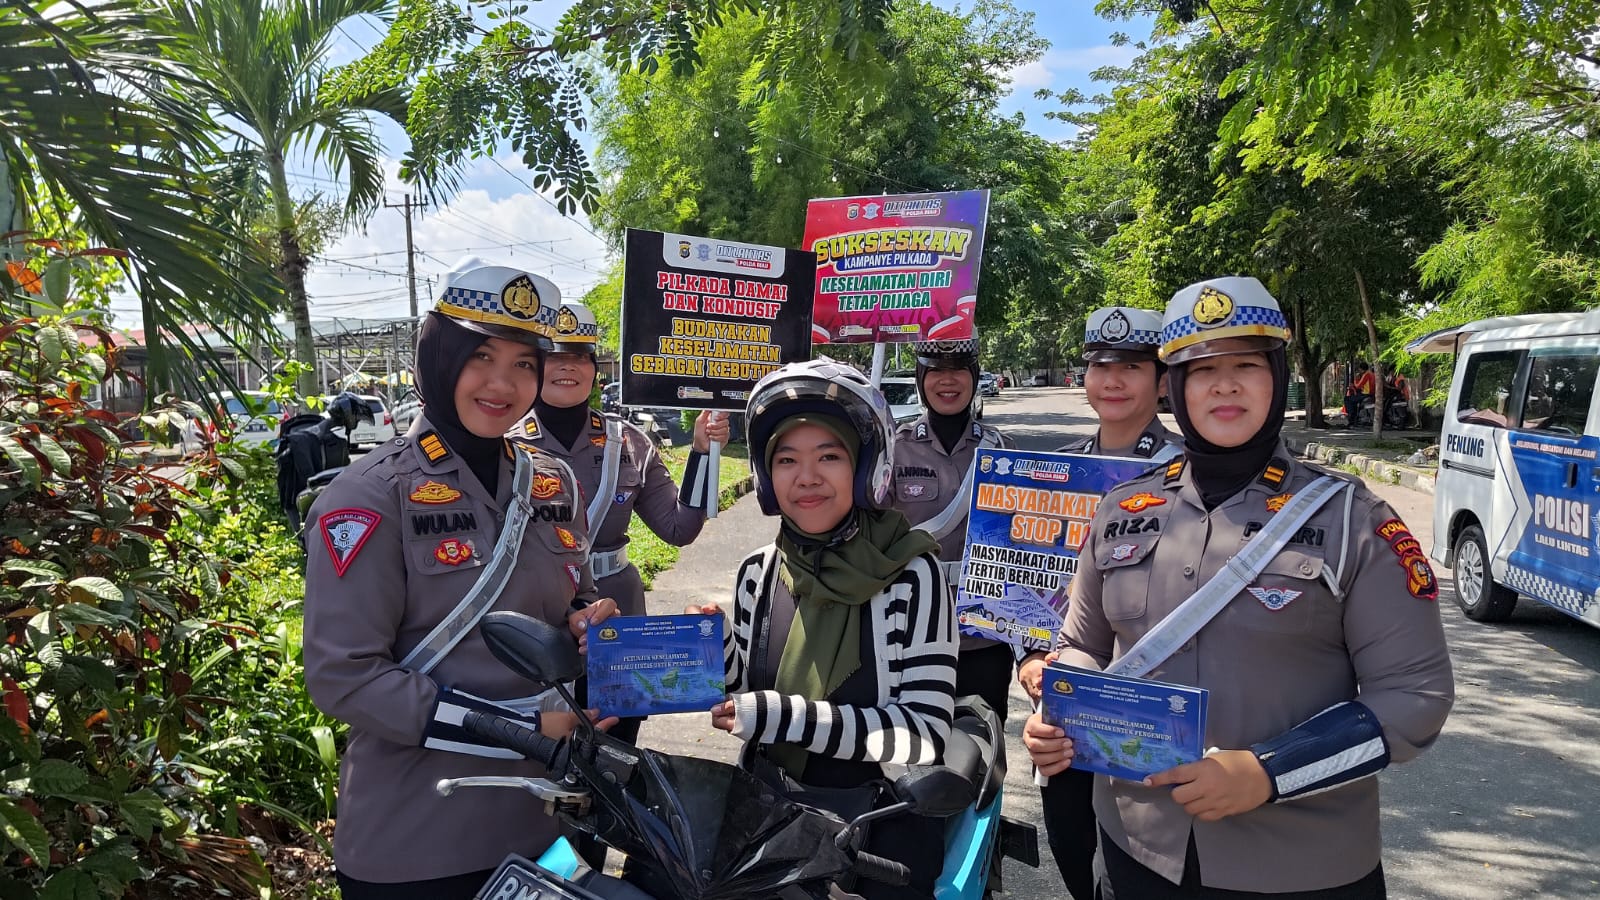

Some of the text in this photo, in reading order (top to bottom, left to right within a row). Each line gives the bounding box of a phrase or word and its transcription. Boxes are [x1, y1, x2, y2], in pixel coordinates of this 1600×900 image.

[883, 199, 941, 211] DITLANTAS
[716, 245, 772, 261] DITLANTAS
[815, 229, 969, 264] SUKSESKAN
[844, 252, 931, 269] KAMPANYE PILKADA
[657, 271, 788, 301] PILKADA DAMAI
[820, 270, 952, 294] KESELAMATAN DIRI
[663, 292, 780, 319] DAN KONDUSIF
[838, 291, 931, 312] TETAP DIJAGA
[672, 317, 771, 344] BUDAYAKAN
[659, 337, 781, 363] KESELAMATAN
[631, 354, 704, 378] SEBAGAI
[1446, 433, 1484, 458] PENLING
[897, 466, 937, 478] ANNISA
[1013, 459, 1070, 474] DITLANTAS
[530, 504, 572, 522] POLRI
[977, 483, 1100, 518] MASYARAKAT
[411, 512, 477, 535] WULAN
[1104, 517, 1160, 539] RIZA
[1534, 493, 1590, 539] POLISI
[1011, 514, 1062, 544] STOP
[1243, 521, 1325, 546] PRI
[1534, 532, 1590, 557] LALU LINTAS
[971, 543, 1079, 575] MASYARAKAT BIJA
[968, 560, 1060, 591] TERTIB BERLALU
[964, 578, 1004, 599] LINTAS
